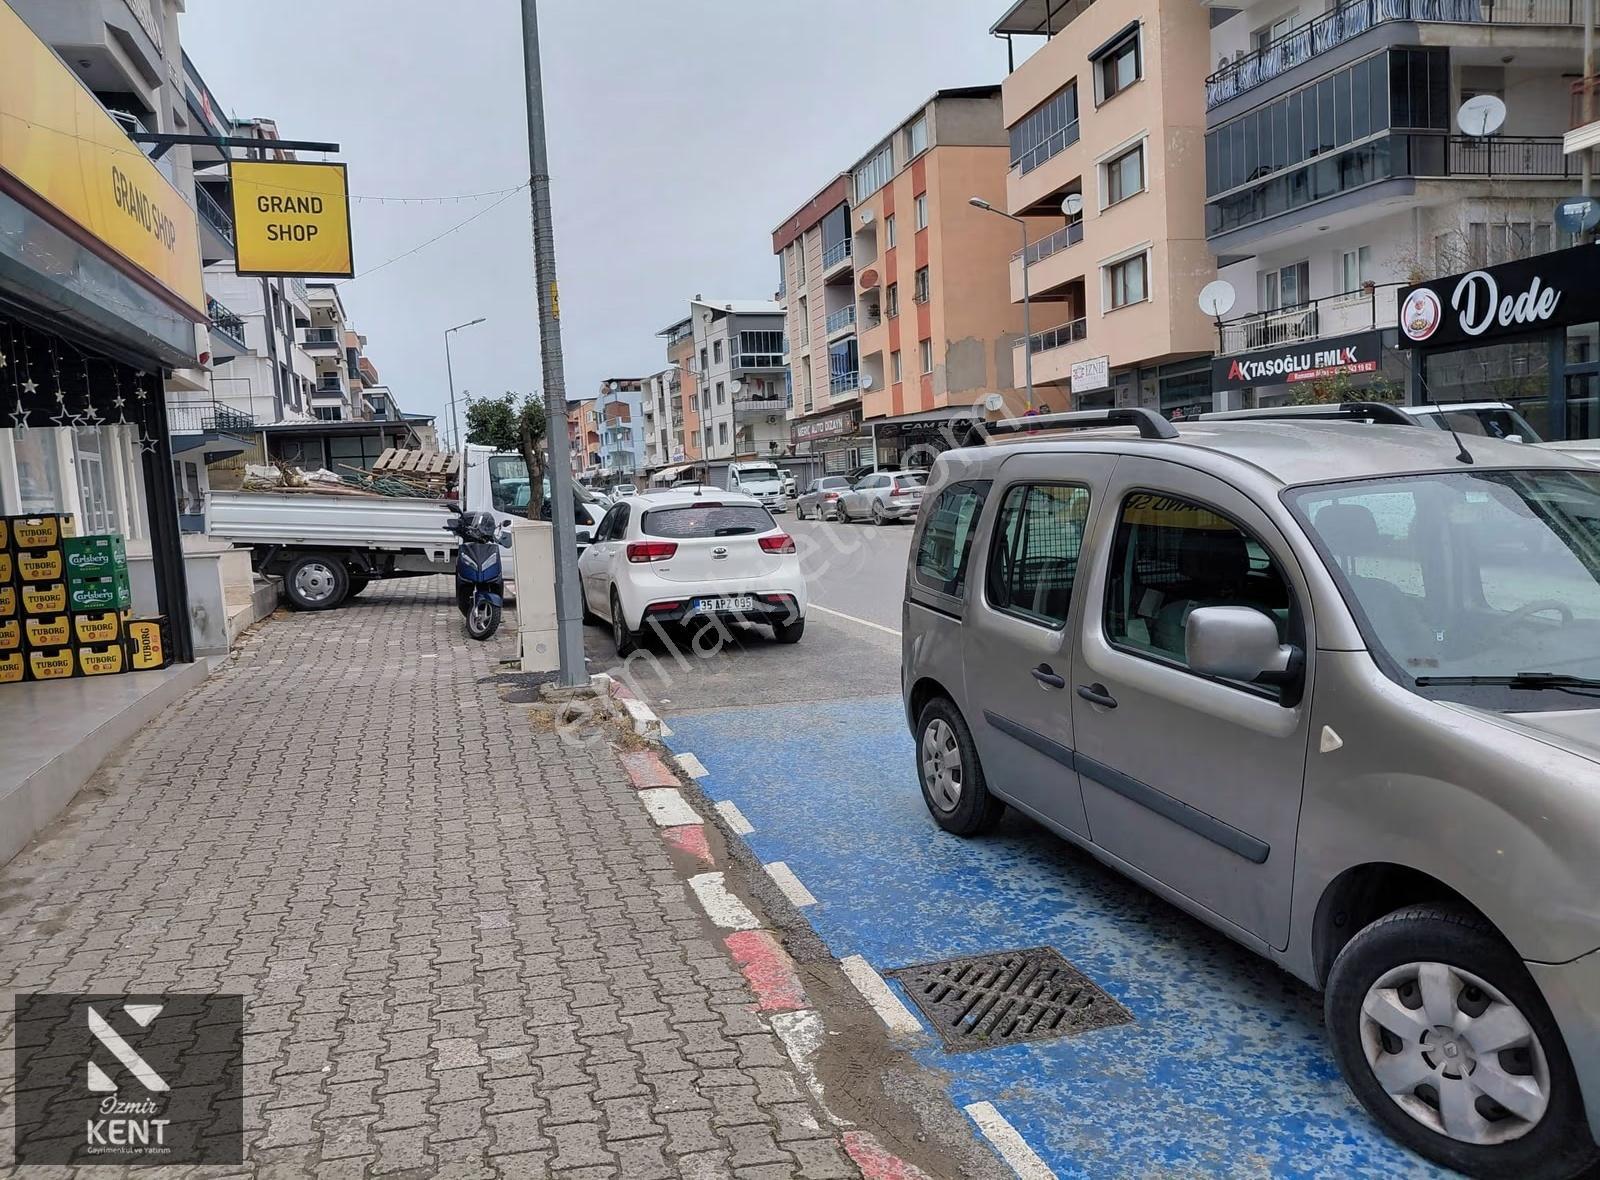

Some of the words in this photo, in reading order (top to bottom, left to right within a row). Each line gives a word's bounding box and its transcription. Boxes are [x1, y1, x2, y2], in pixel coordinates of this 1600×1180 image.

[112, 165, 152, 233] GRAND
[151, 203, 176, 253] SHOP
[257, 195, 324, 215] GRAND
[266, 223, 319, 242] SHOP
[1451, 270, 1562, 336] Dede
[1227, 353, 1310, 382] AKTAŞOĞLU
[901, 422, 935, 431] CAM
[19, 528, 53, 538] TUBORG
[68, 551, 109, 567] Carlsberg
[23, 561, 57, 571] TUBORG
[28, 594, 61, 604] TUBORG
[73, 589, 114, 604] Carlsberg
[700, 600, 713, 610] 35
[715, 599, 733, 610] APZ
[734, 597, 752, 608] 095
[32, 626, 65, 637] TUBORG
[80, 622, 114, 633] TUBORG
[141, 627, 153, 663] TUBORG
[36, 659, 69, 669] TUBORG
[84, 655, 117, 665] TUBORG
